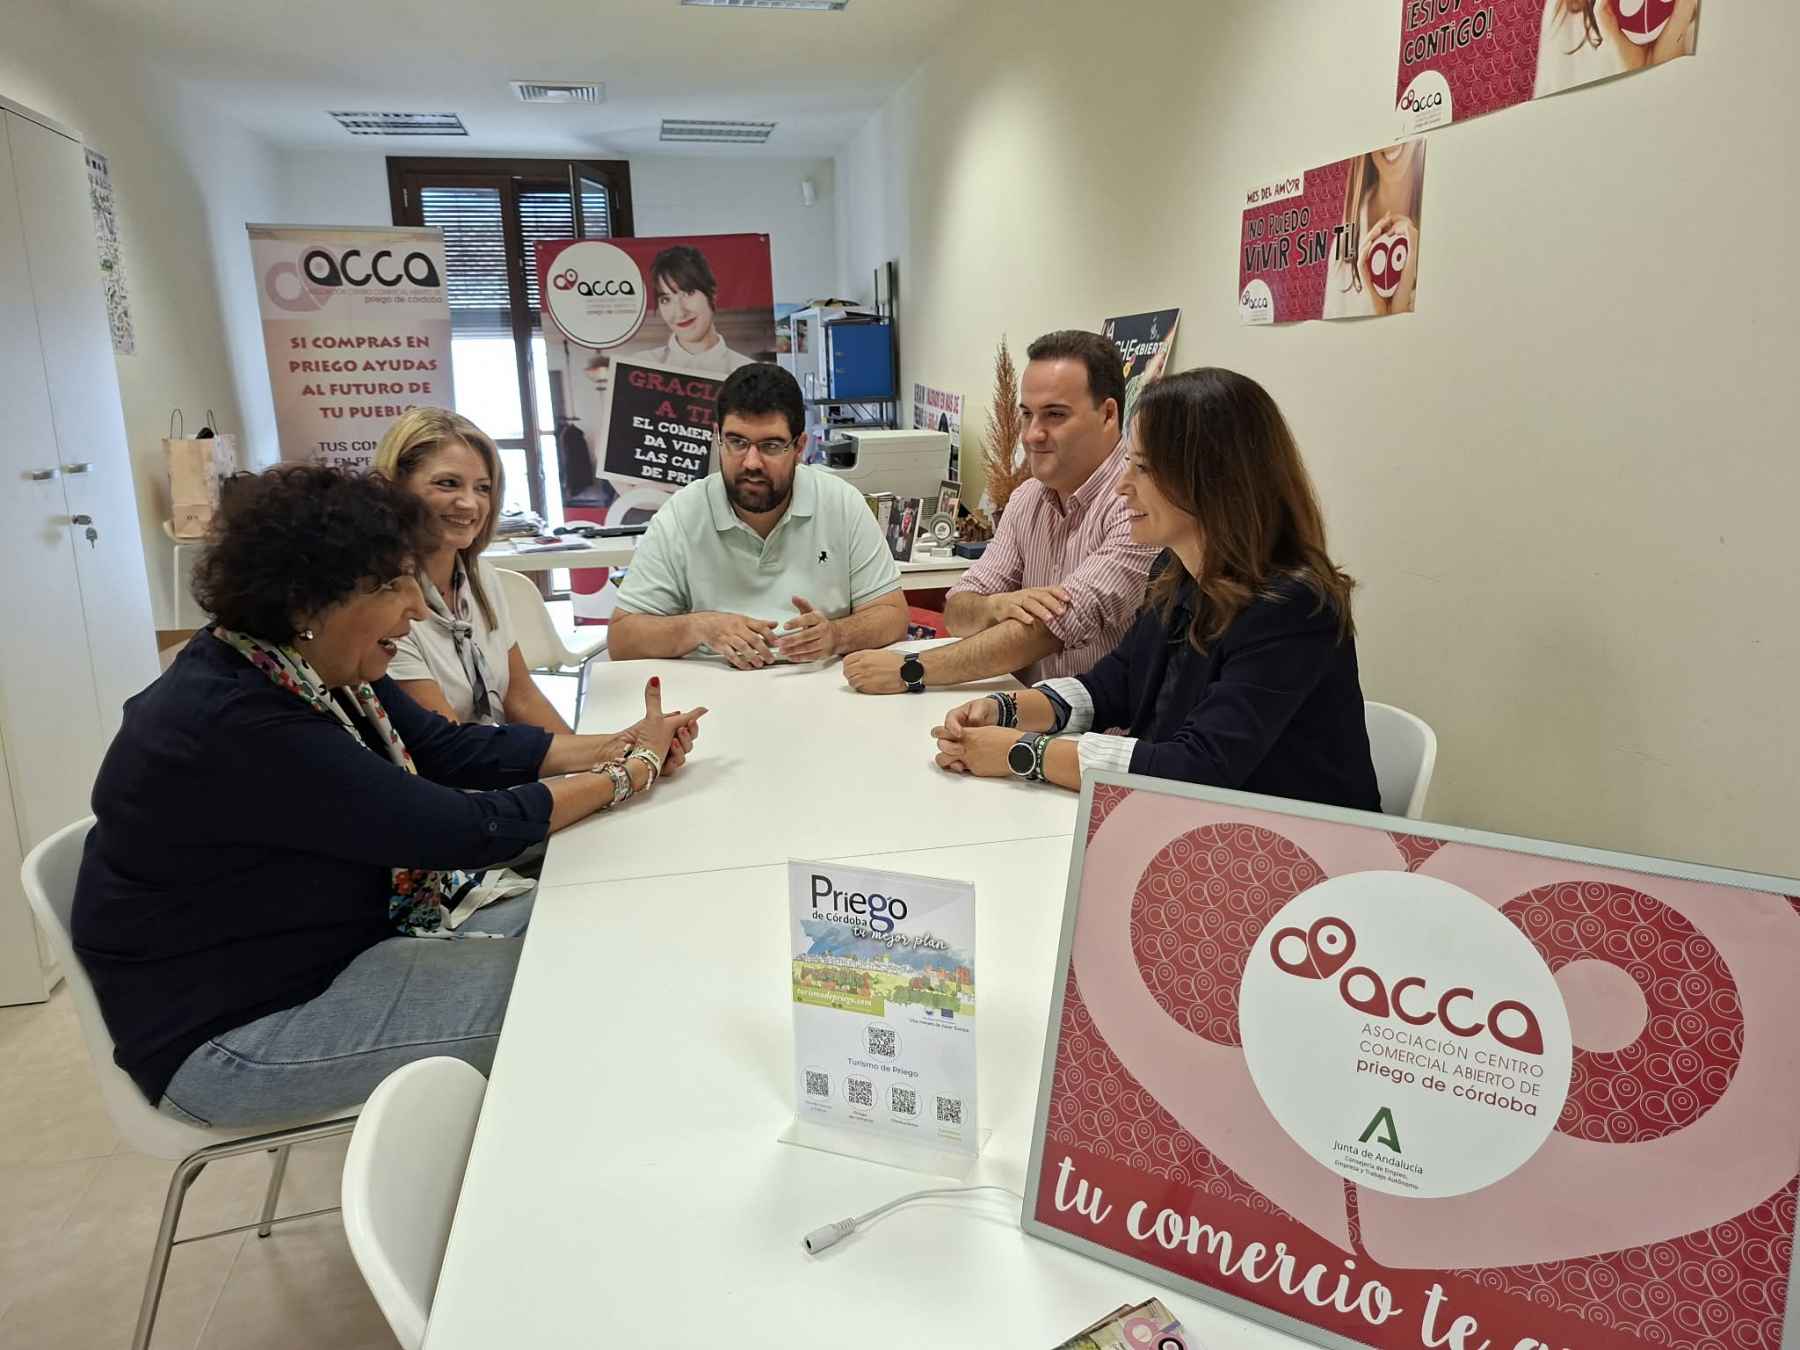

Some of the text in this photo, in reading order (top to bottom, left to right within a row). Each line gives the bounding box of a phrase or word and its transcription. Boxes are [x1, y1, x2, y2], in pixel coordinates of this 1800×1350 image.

[1247, 190, 1259, 204] MES
[1261, 186, 1272, 200] DEL
[1268, 207, 1310, 237] PUEDO
[290, 336, 430, 349] SI COMPRAS EN
[289, 359, 438, 373] PRIEGO AYUDAS
[301, 382, 432, 397] AL FUTURO DE
[320, 407, 344, 418] TU
[655, 400, 676, 419] A
[632, 416, 653, 431] EL
[318, 441, 348, 452] TUS
[644, 434, 707, 456] DA VIDA
[634, 448, 668, 464] LAS
[641, 465, 663, 479] DE
[811, 874, 908, 933] Priego
[812, 911, 868, 926] de Córdoba
[853, 925, 950, 951] tu mejor plan
[1361, 1023, 1544, 1078] ASOCIACIÓN CENTRO
[847, 1057, 919, 1079] Turismo de Priego
[1359, 1040, 1541, 1097] COMERCIAL ABIERTO DE
[1356, 1058, 1538, 1116] priego de córdoba
[1333, 1140, 1424, 1175] Junta de Andalucía
[1054, 1156, 1112, 1224] tu
[1127, 1200, 1404, 1325] comercio
